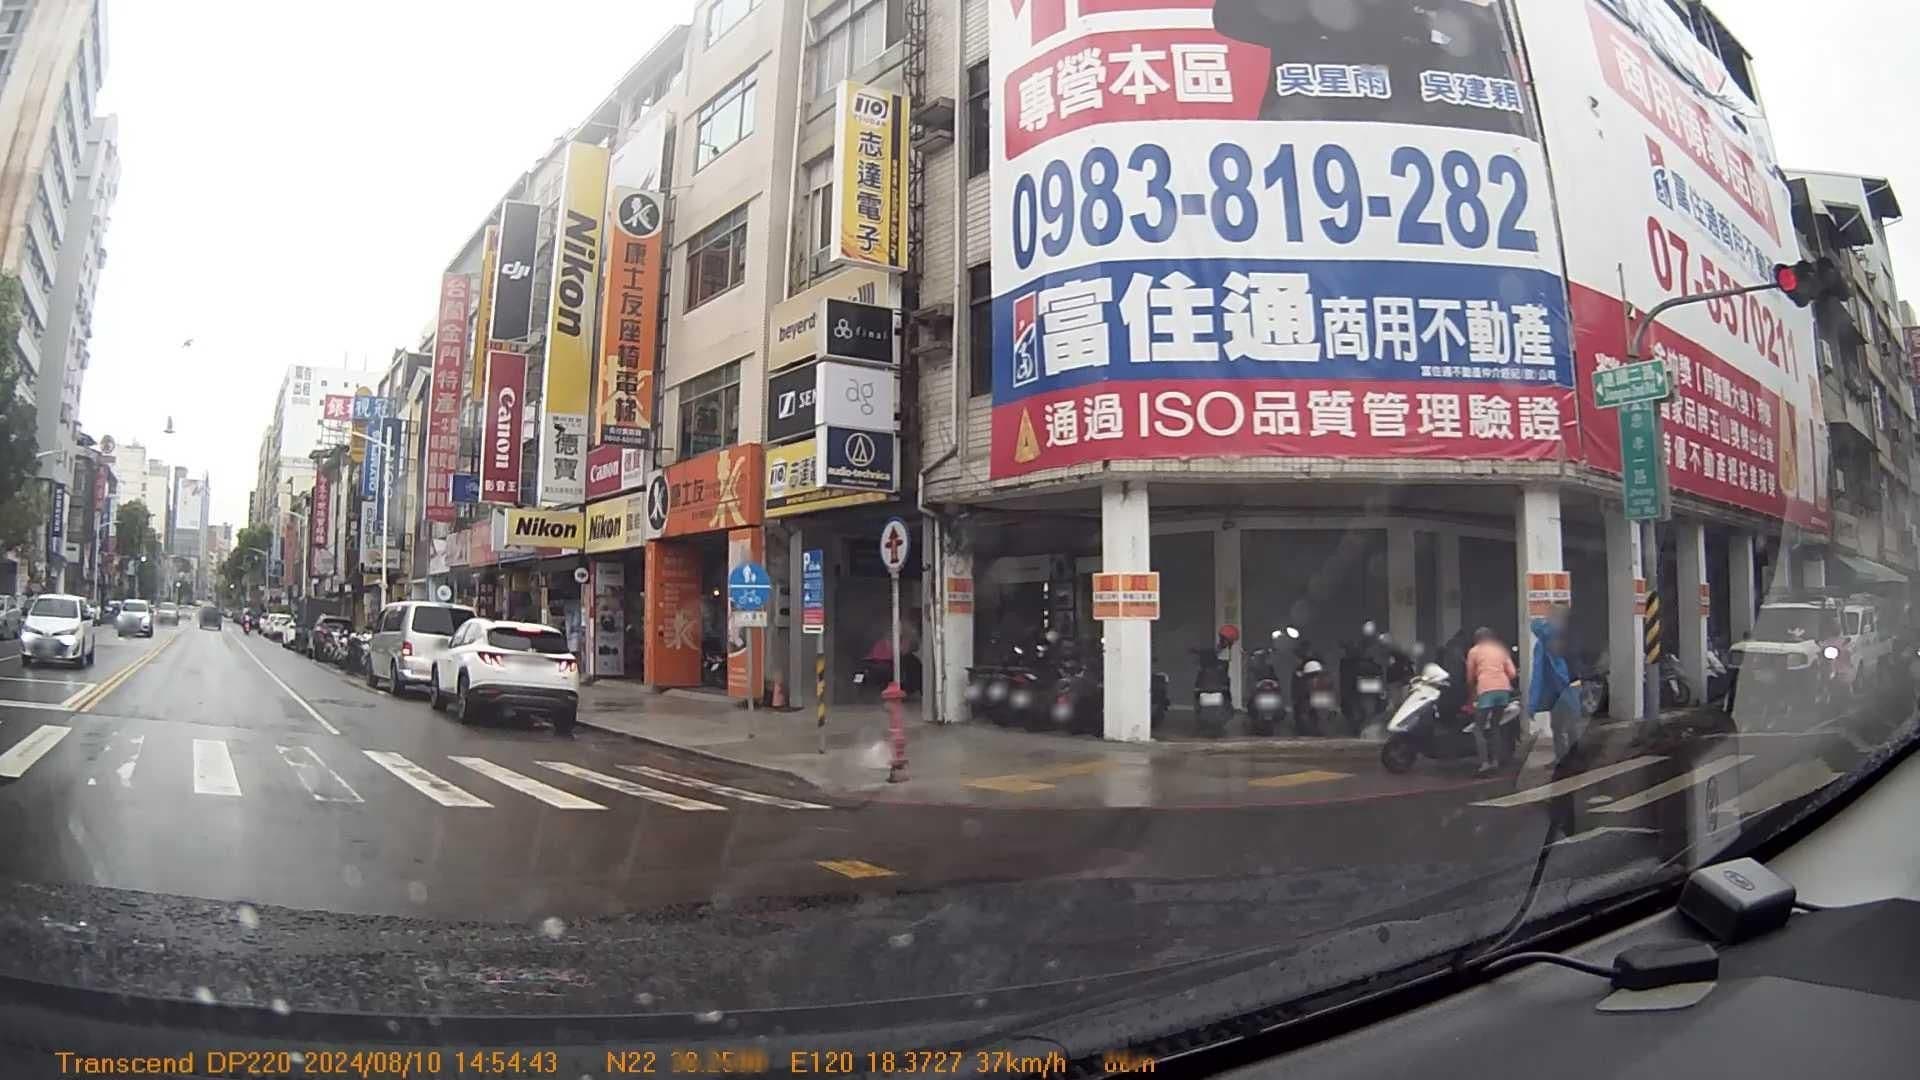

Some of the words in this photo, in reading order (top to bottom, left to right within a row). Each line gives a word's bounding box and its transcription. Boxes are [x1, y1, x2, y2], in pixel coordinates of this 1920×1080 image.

[1018, 43, 1234, 134] 專營本區
[1276, 63, 1391, 99] 吳星雨
[856, 131, 883, 254] 志達電子
[1012, 142, 1538, 271] 0983-819-282
[501, 261, 531, 280] dji
[556, 209, 598, 338] Nikon
[1037, 271, 1321, 377] 富住通
[1321, 296, 1556, 366] 商用不動產
[846, 378, 874, 415] ag
[495, 387, 516, 470] Canon
[590, 460, 619, 483] Canon
[515, 516, 578, 539] Nikon
[589, 513, 622, 541] Nikon
